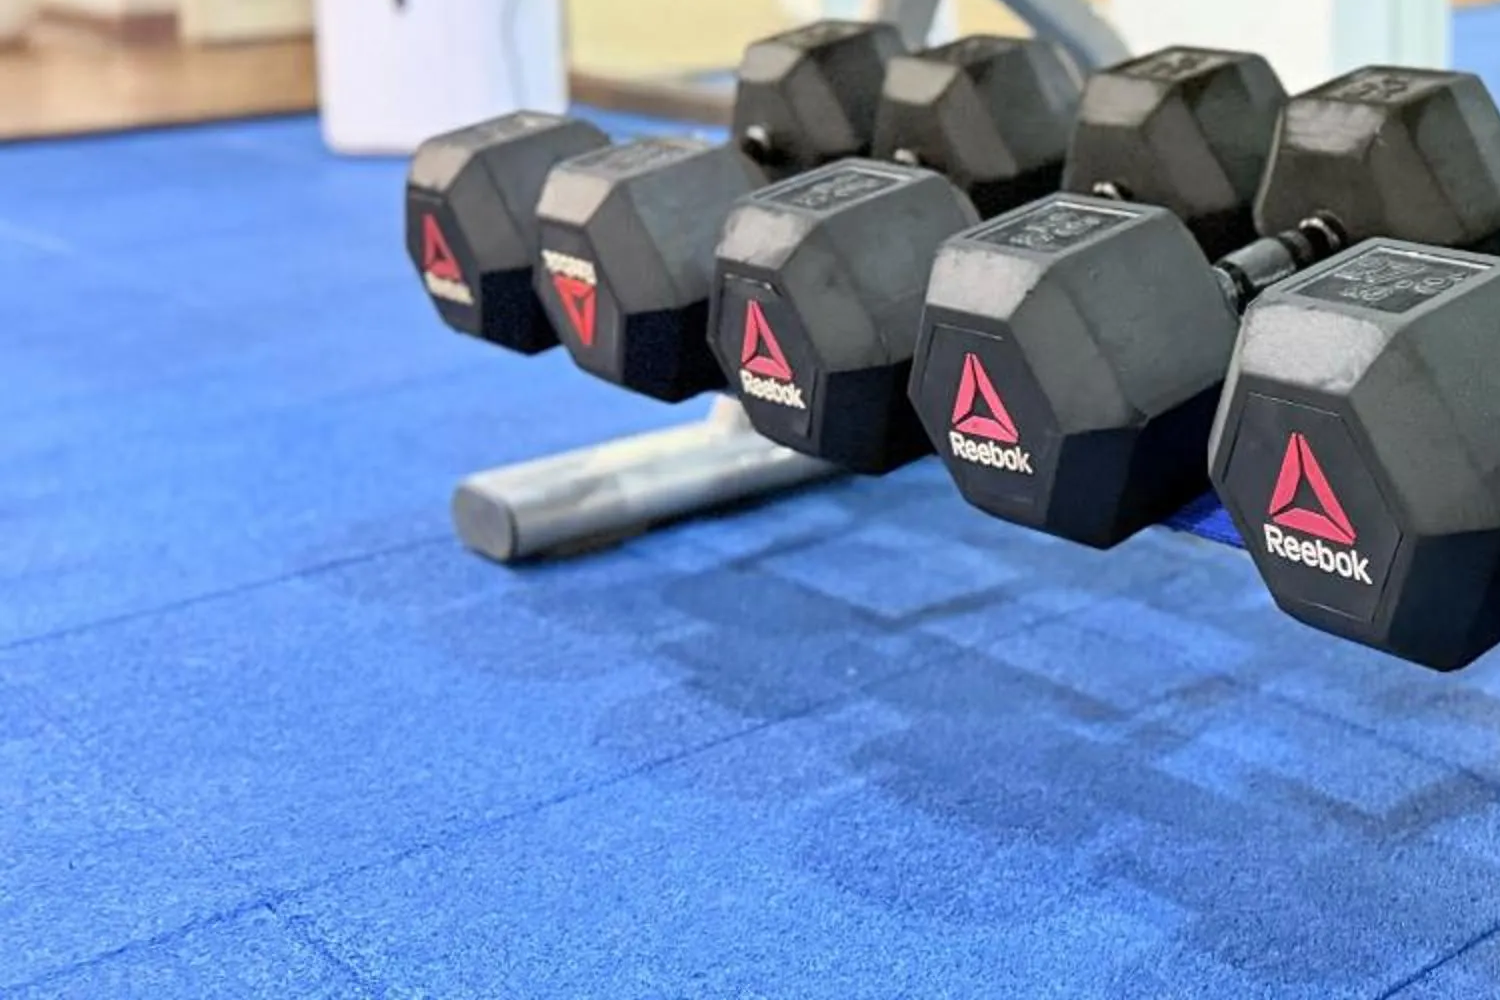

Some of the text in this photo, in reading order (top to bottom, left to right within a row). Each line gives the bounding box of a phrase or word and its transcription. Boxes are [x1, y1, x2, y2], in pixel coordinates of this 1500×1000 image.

[739, 368, 807, 410] Reebok
[949, 430, 1033, 474] Reebok
[1263, 523, 1373, 585] Reebok
